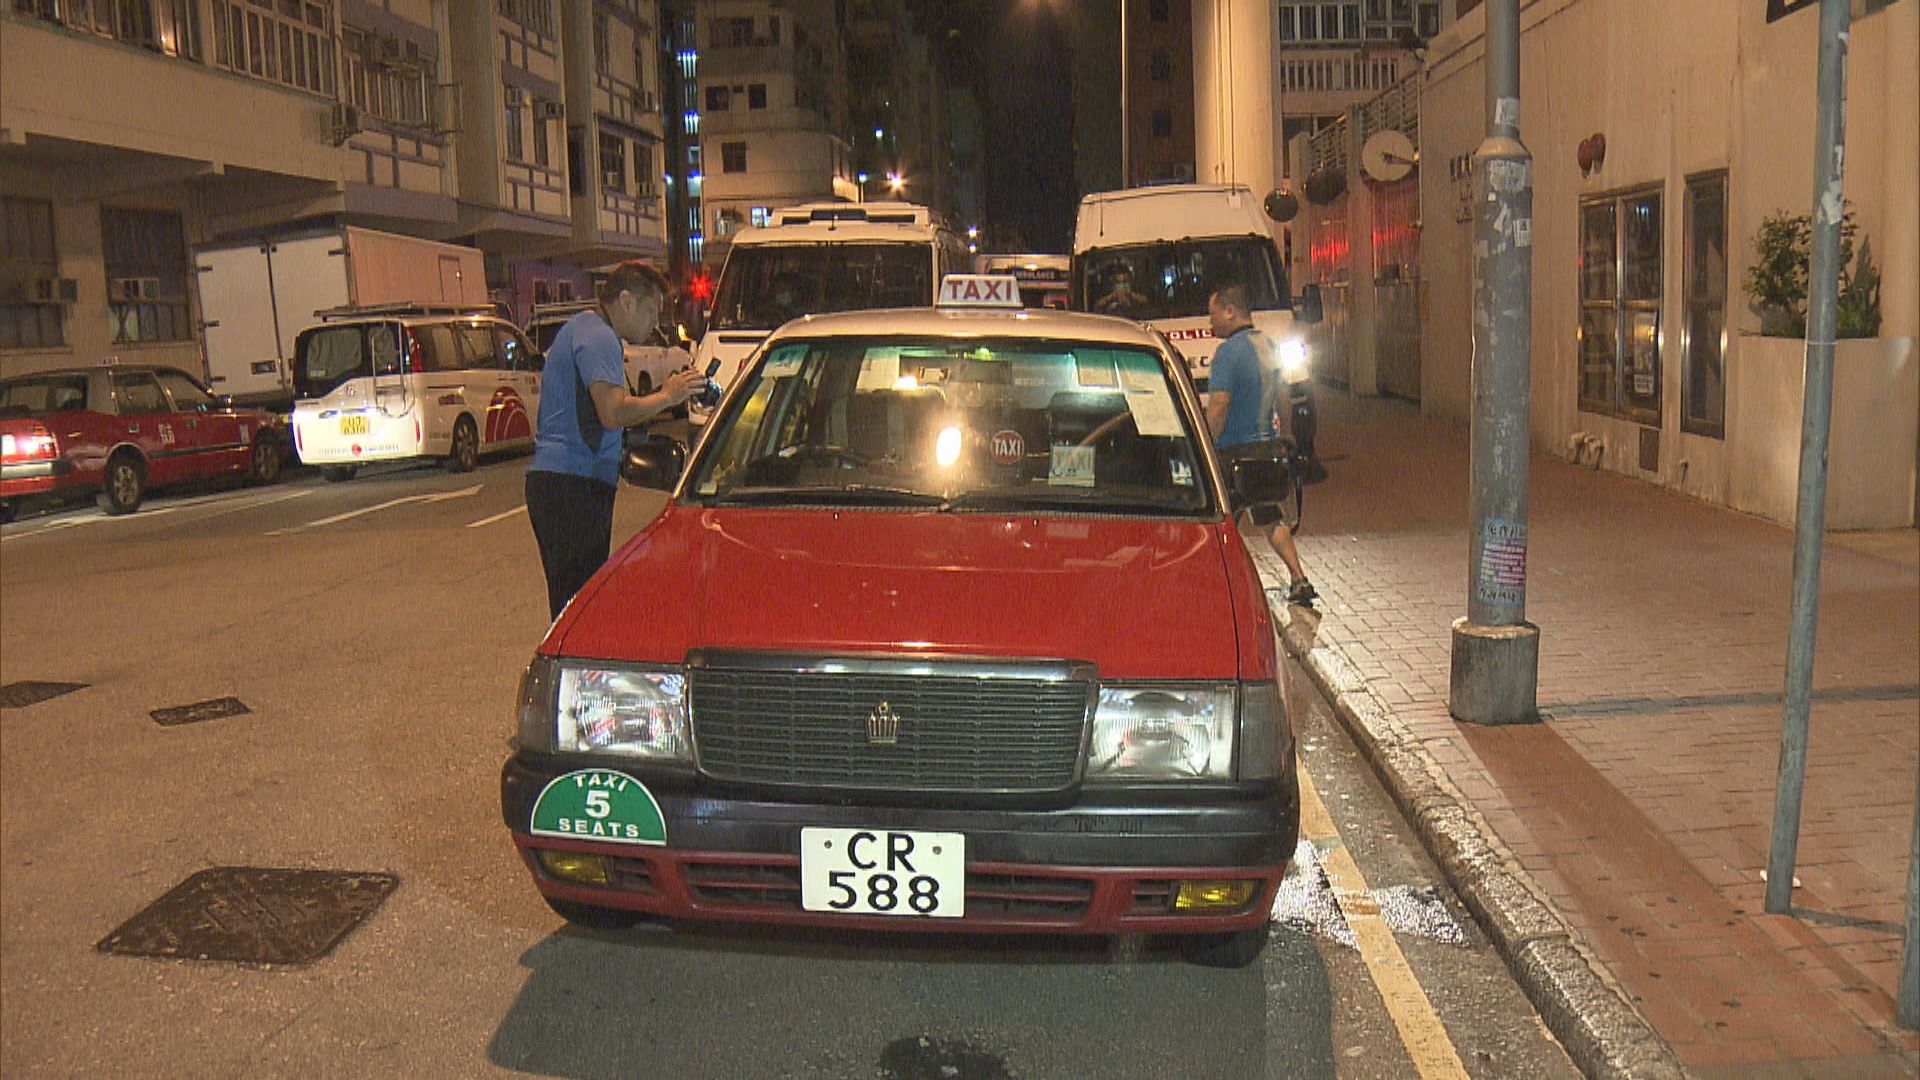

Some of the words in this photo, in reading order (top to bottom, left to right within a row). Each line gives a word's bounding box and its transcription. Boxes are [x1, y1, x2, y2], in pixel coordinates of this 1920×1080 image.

[947, 280, 1012, 300] TAXI
[995, 438, 1021, 457] TAXI
[1055, 448, 1092, 469] TAXI
[573, 774, 629, 792] TAXI
[585, 789, 611, 819] 5
[559, 818, 639, 838] SEATS
[847, 831, 917, 872] CR
[827, 870, 940, 913] 588
